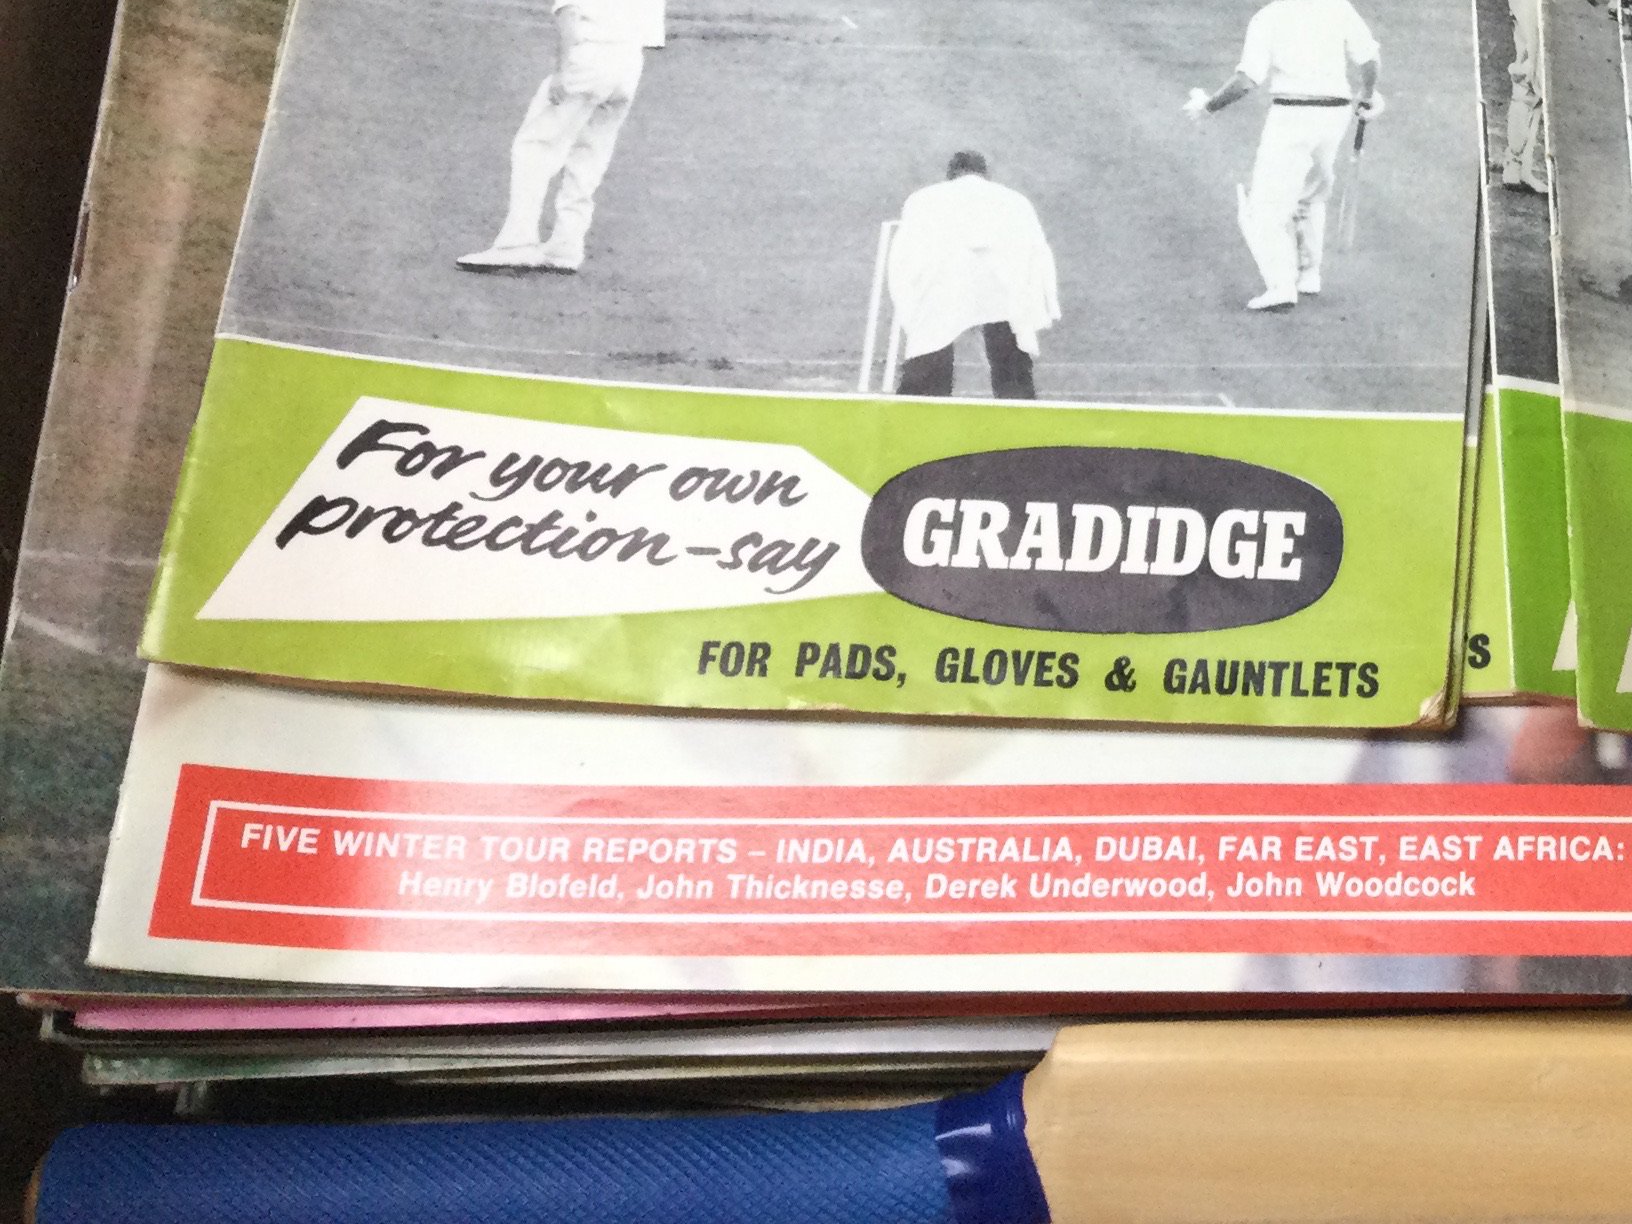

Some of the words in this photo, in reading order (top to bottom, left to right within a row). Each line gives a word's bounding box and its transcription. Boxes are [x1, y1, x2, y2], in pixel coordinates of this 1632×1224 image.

[336, 419, 484, 480] For
[468, 447, 668, 501] your
[669, 466, 807, 507] own
[903, 497, 1306, 581] GRADIDGE
[697, 640, 772, 677] FOR
[795, 642, 907, 690] PADS,
[935, 646, 1080, 690] GLOVES
[1104, 655, 1137, 693] &
[1163, 658, 1380, 699] GAUNTLETS
[241, 823, 318, 855] FIVE
[333, 829, 466, 862] WINTER
[480, 834, 569, 864] TOUR
[583, 837, 737, 864] REPORTS
[776, 837, 877, 870] INDIA,
[888, 835, 1083, 866] AUSTRALIA,
[1095, 835, 1206, 866] DUBAI,
[1217, 835, 1282, 862] FAR
[1294, 835, 1387, 866] EAST,
[1398, 835, 1482, 862] EAST
[1493, 835, 1627, 862] AFRICA:
[397, 874, 493, 906] Henry
[506, 873, 626, 903] Blofeld,
[637, 874, 714, 901] John
[726, 874, 912, 905] Thicknesse,
[925, 873, 1017, 900] Derek
[1029, 873, 1214, 903] Underwood,
[1226, 872, 1302, 898] John
[1315, 871, 1477, 898] Woodcock
